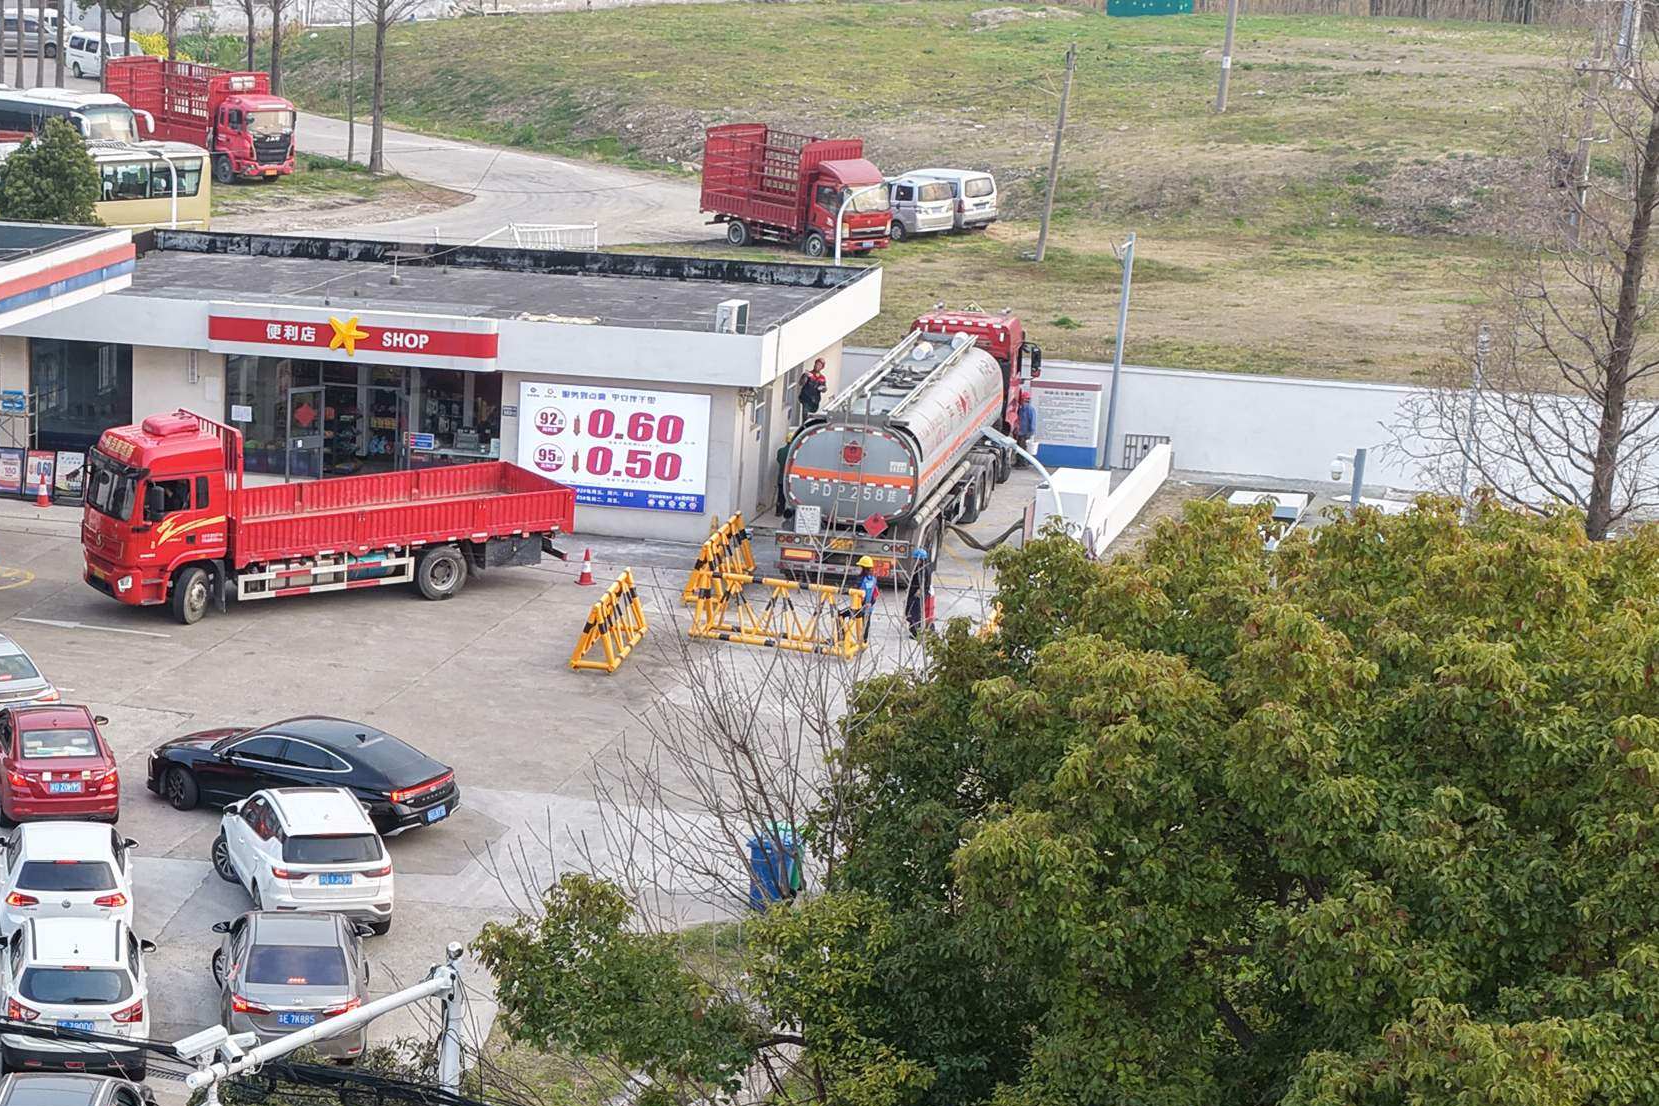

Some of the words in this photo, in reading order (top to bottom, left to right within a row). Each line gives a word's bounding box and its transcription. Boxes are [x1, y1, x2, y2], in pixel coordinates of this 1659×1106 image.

[266, 323, 317, 342] 便利店
[382, 331, 429, 350] SHOP
[587, 408, 684, 444] 0.60
[586, 446, 682, 481] 0.50
